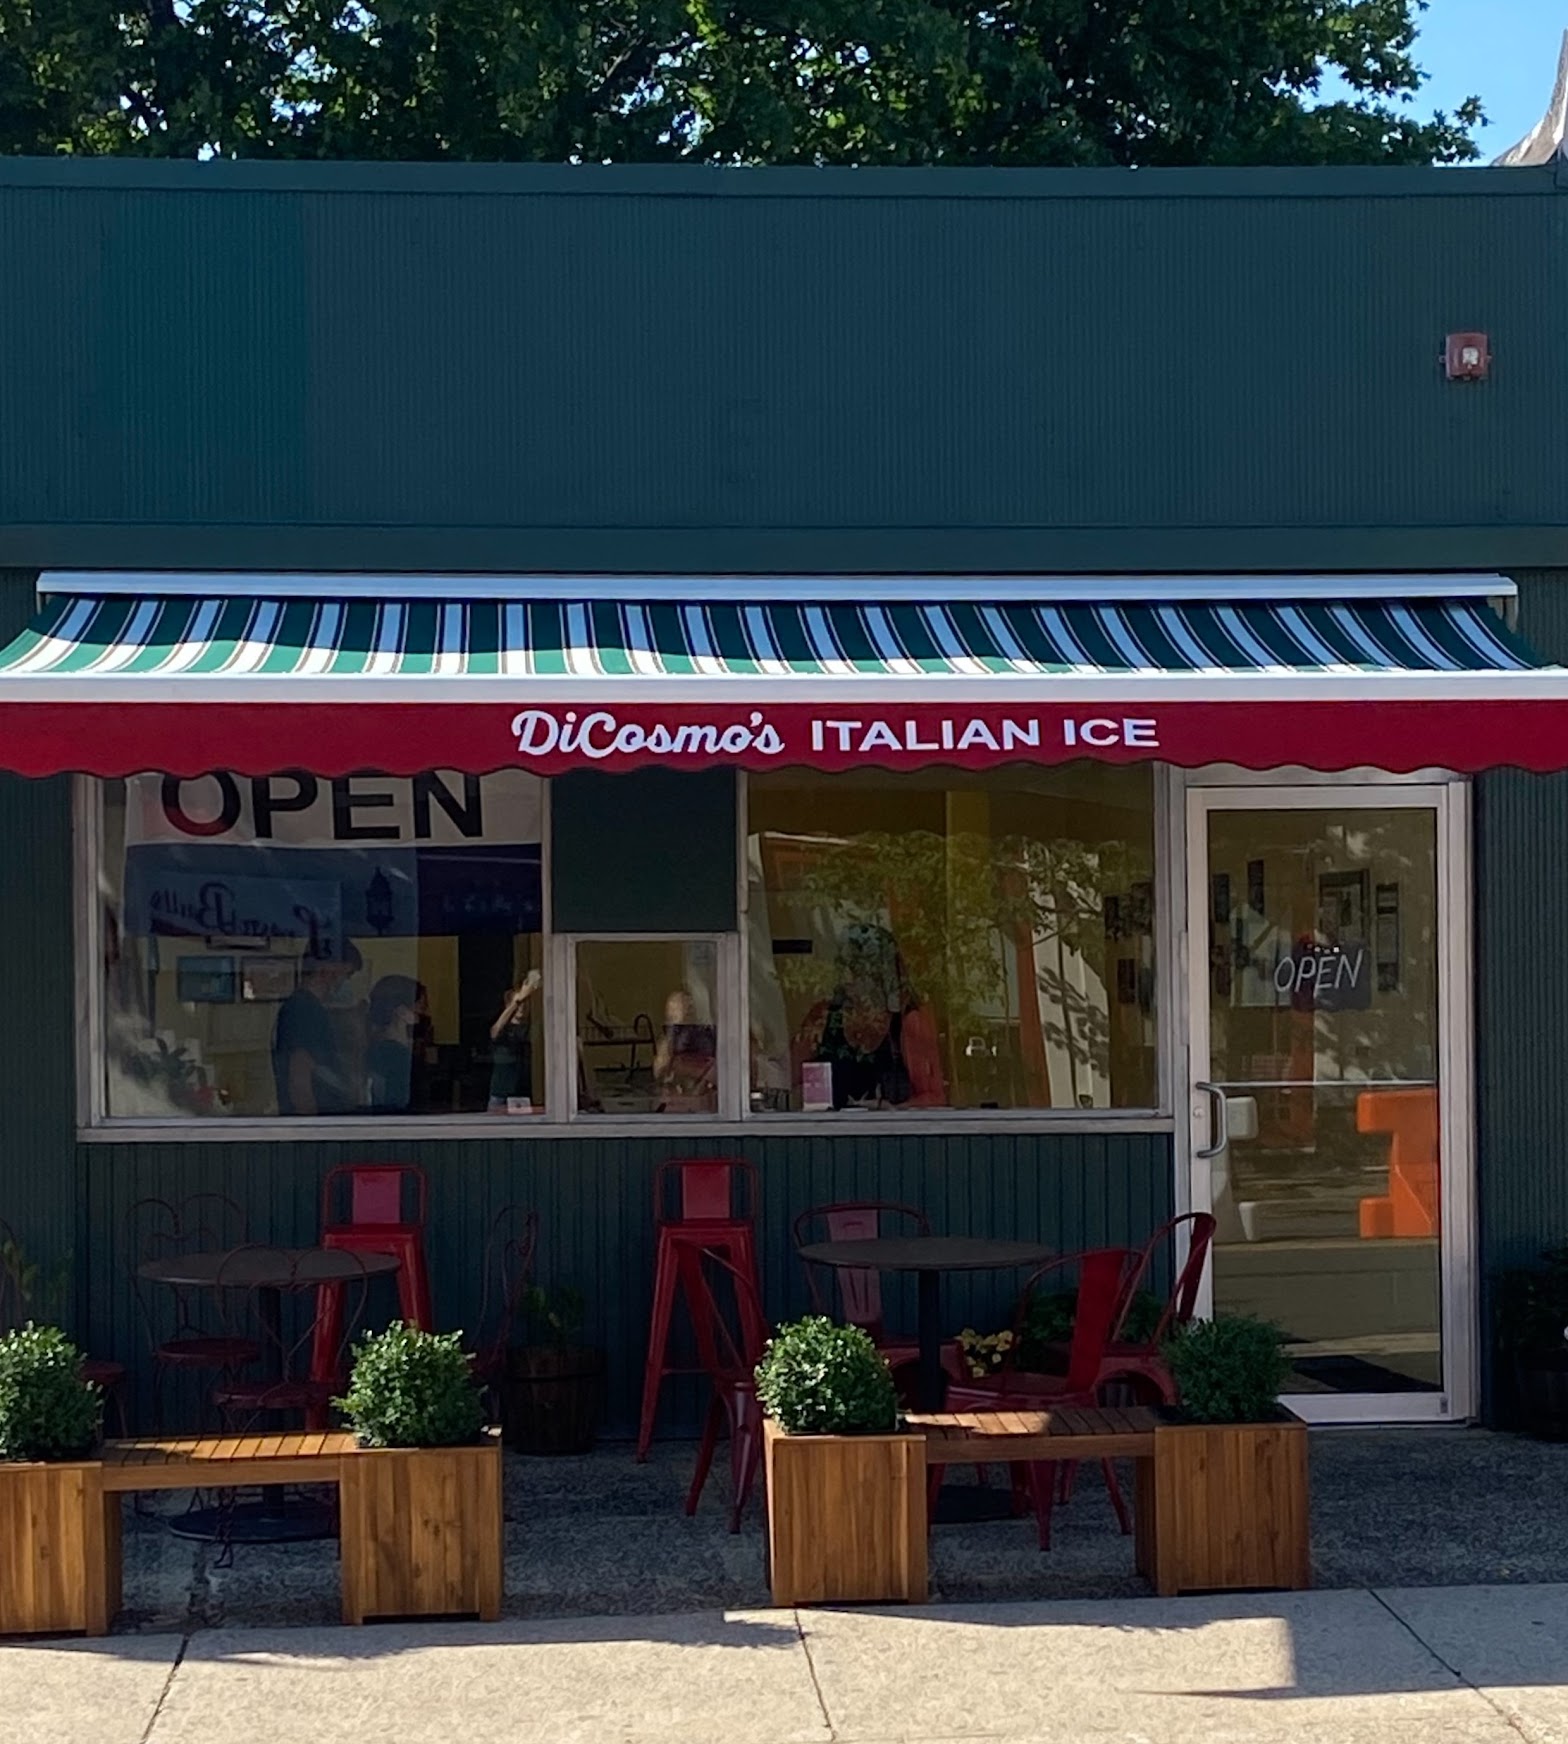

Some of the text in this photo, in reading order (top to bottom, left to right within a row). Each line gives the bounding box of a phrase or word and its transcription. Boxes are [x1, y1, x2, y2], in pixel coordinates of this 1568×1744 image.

[511, 710, 1160, 758] DiCosmo's ITALIAN ICE
[161, 772, 483, 839] OPEN
[1275, 949, 1363, 999] OPEN
